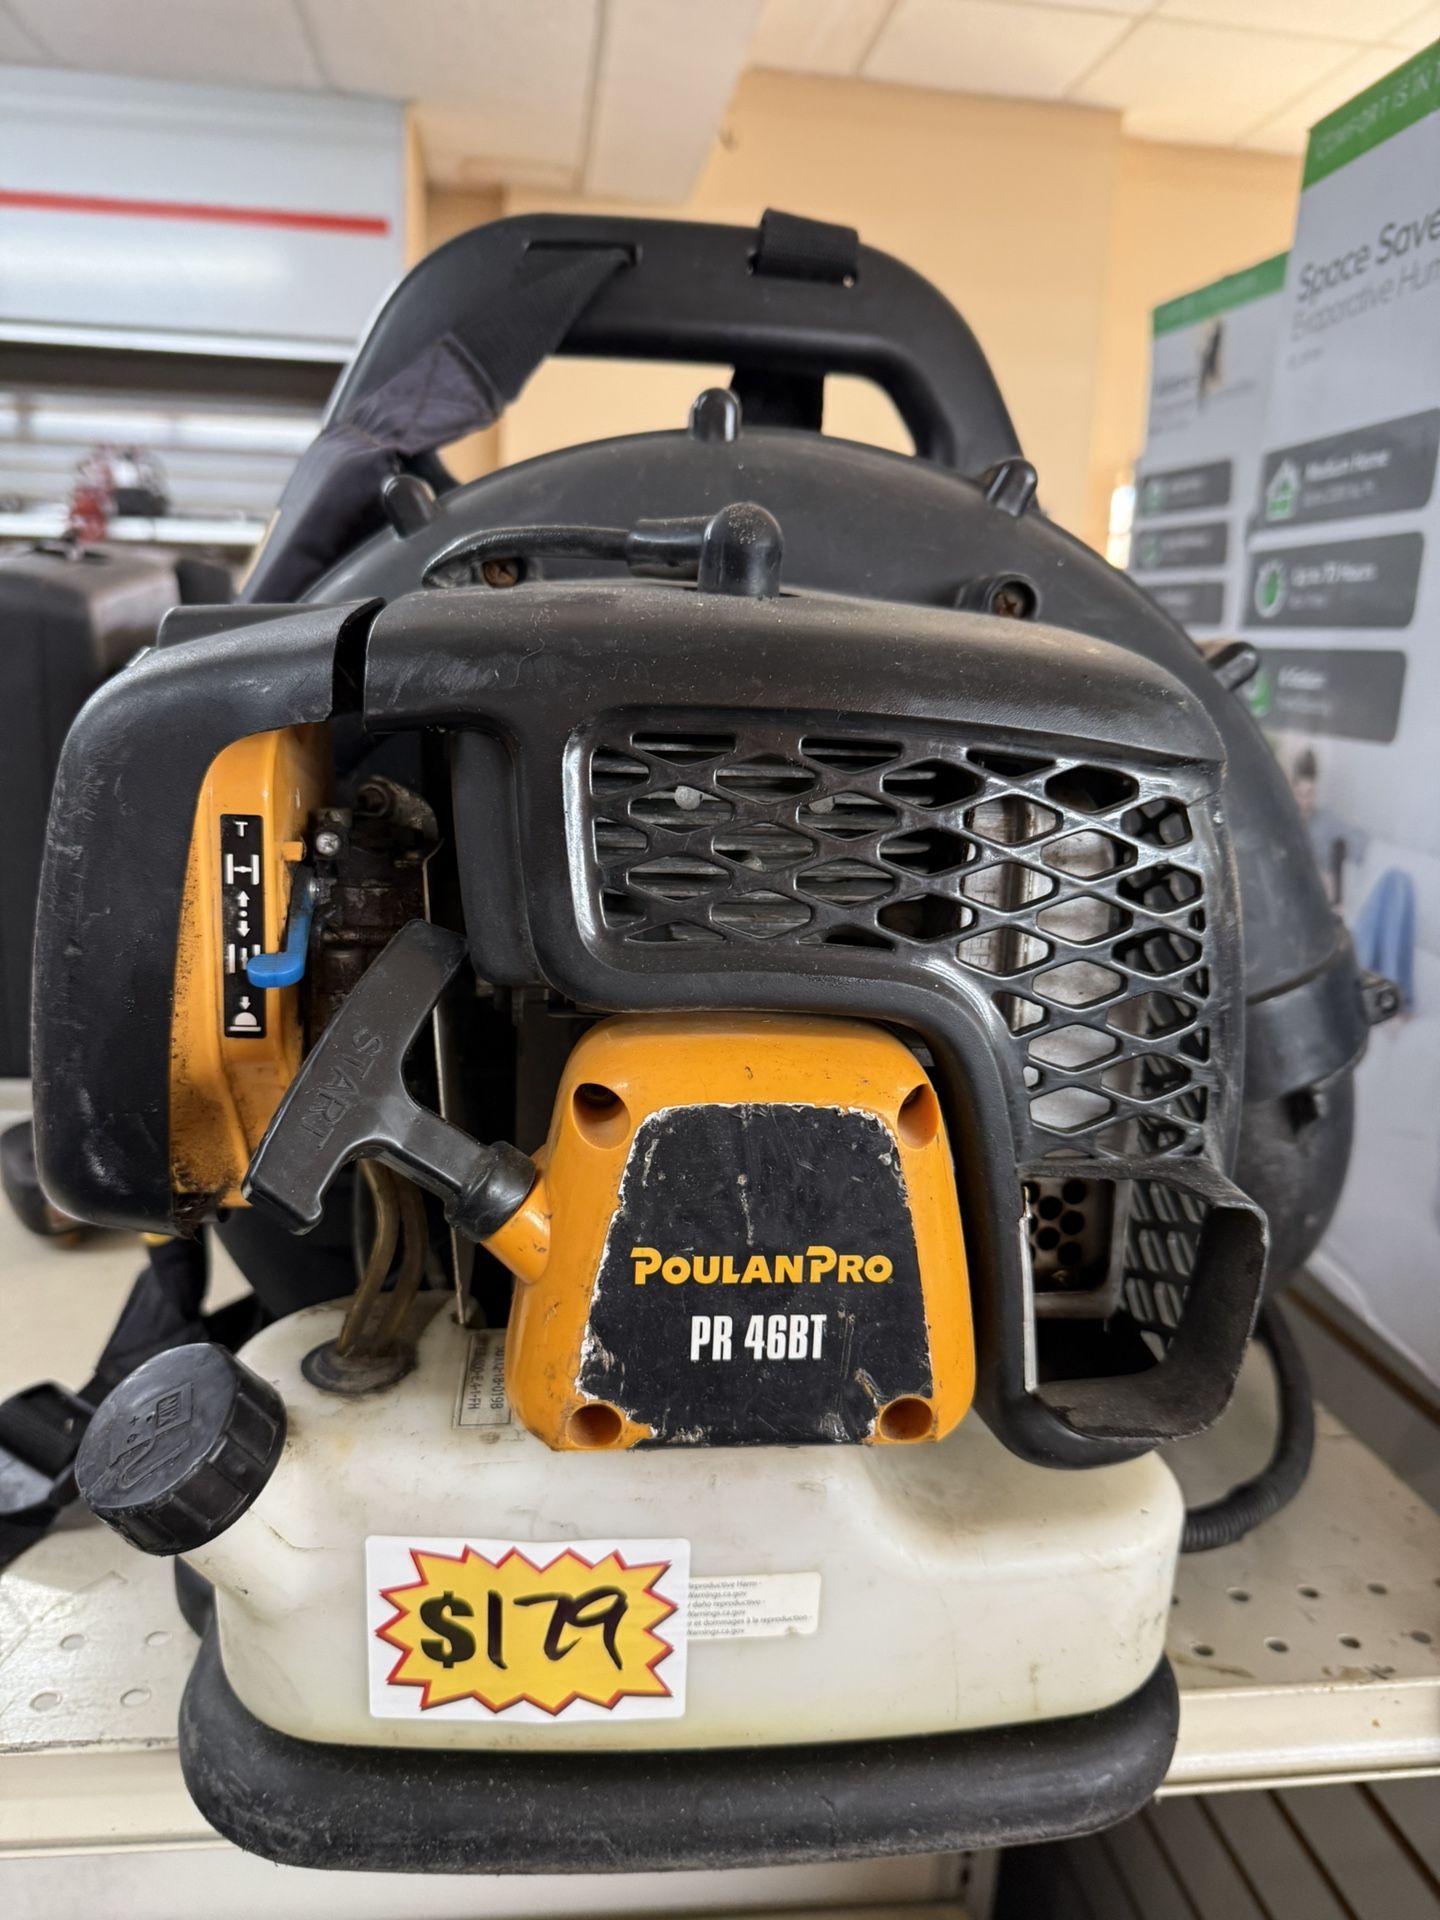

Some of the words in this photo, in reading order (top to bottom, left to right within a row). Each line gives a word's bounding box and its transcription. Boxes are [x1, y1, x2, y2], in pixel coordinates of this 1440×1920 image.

[1297, 245, 1371, 307] Space
[1290, 277, 1395, 343] Evaporative
[235, 821, 249, 837] T
[301, 1024, 384, 1151] START
[690, 1315, 733, 1361] PR
[744, 1314, 827, 1361] 46BT
[688, 1582, 735, 1590] eproductive
[419, 1585, 629, 1671] $179
